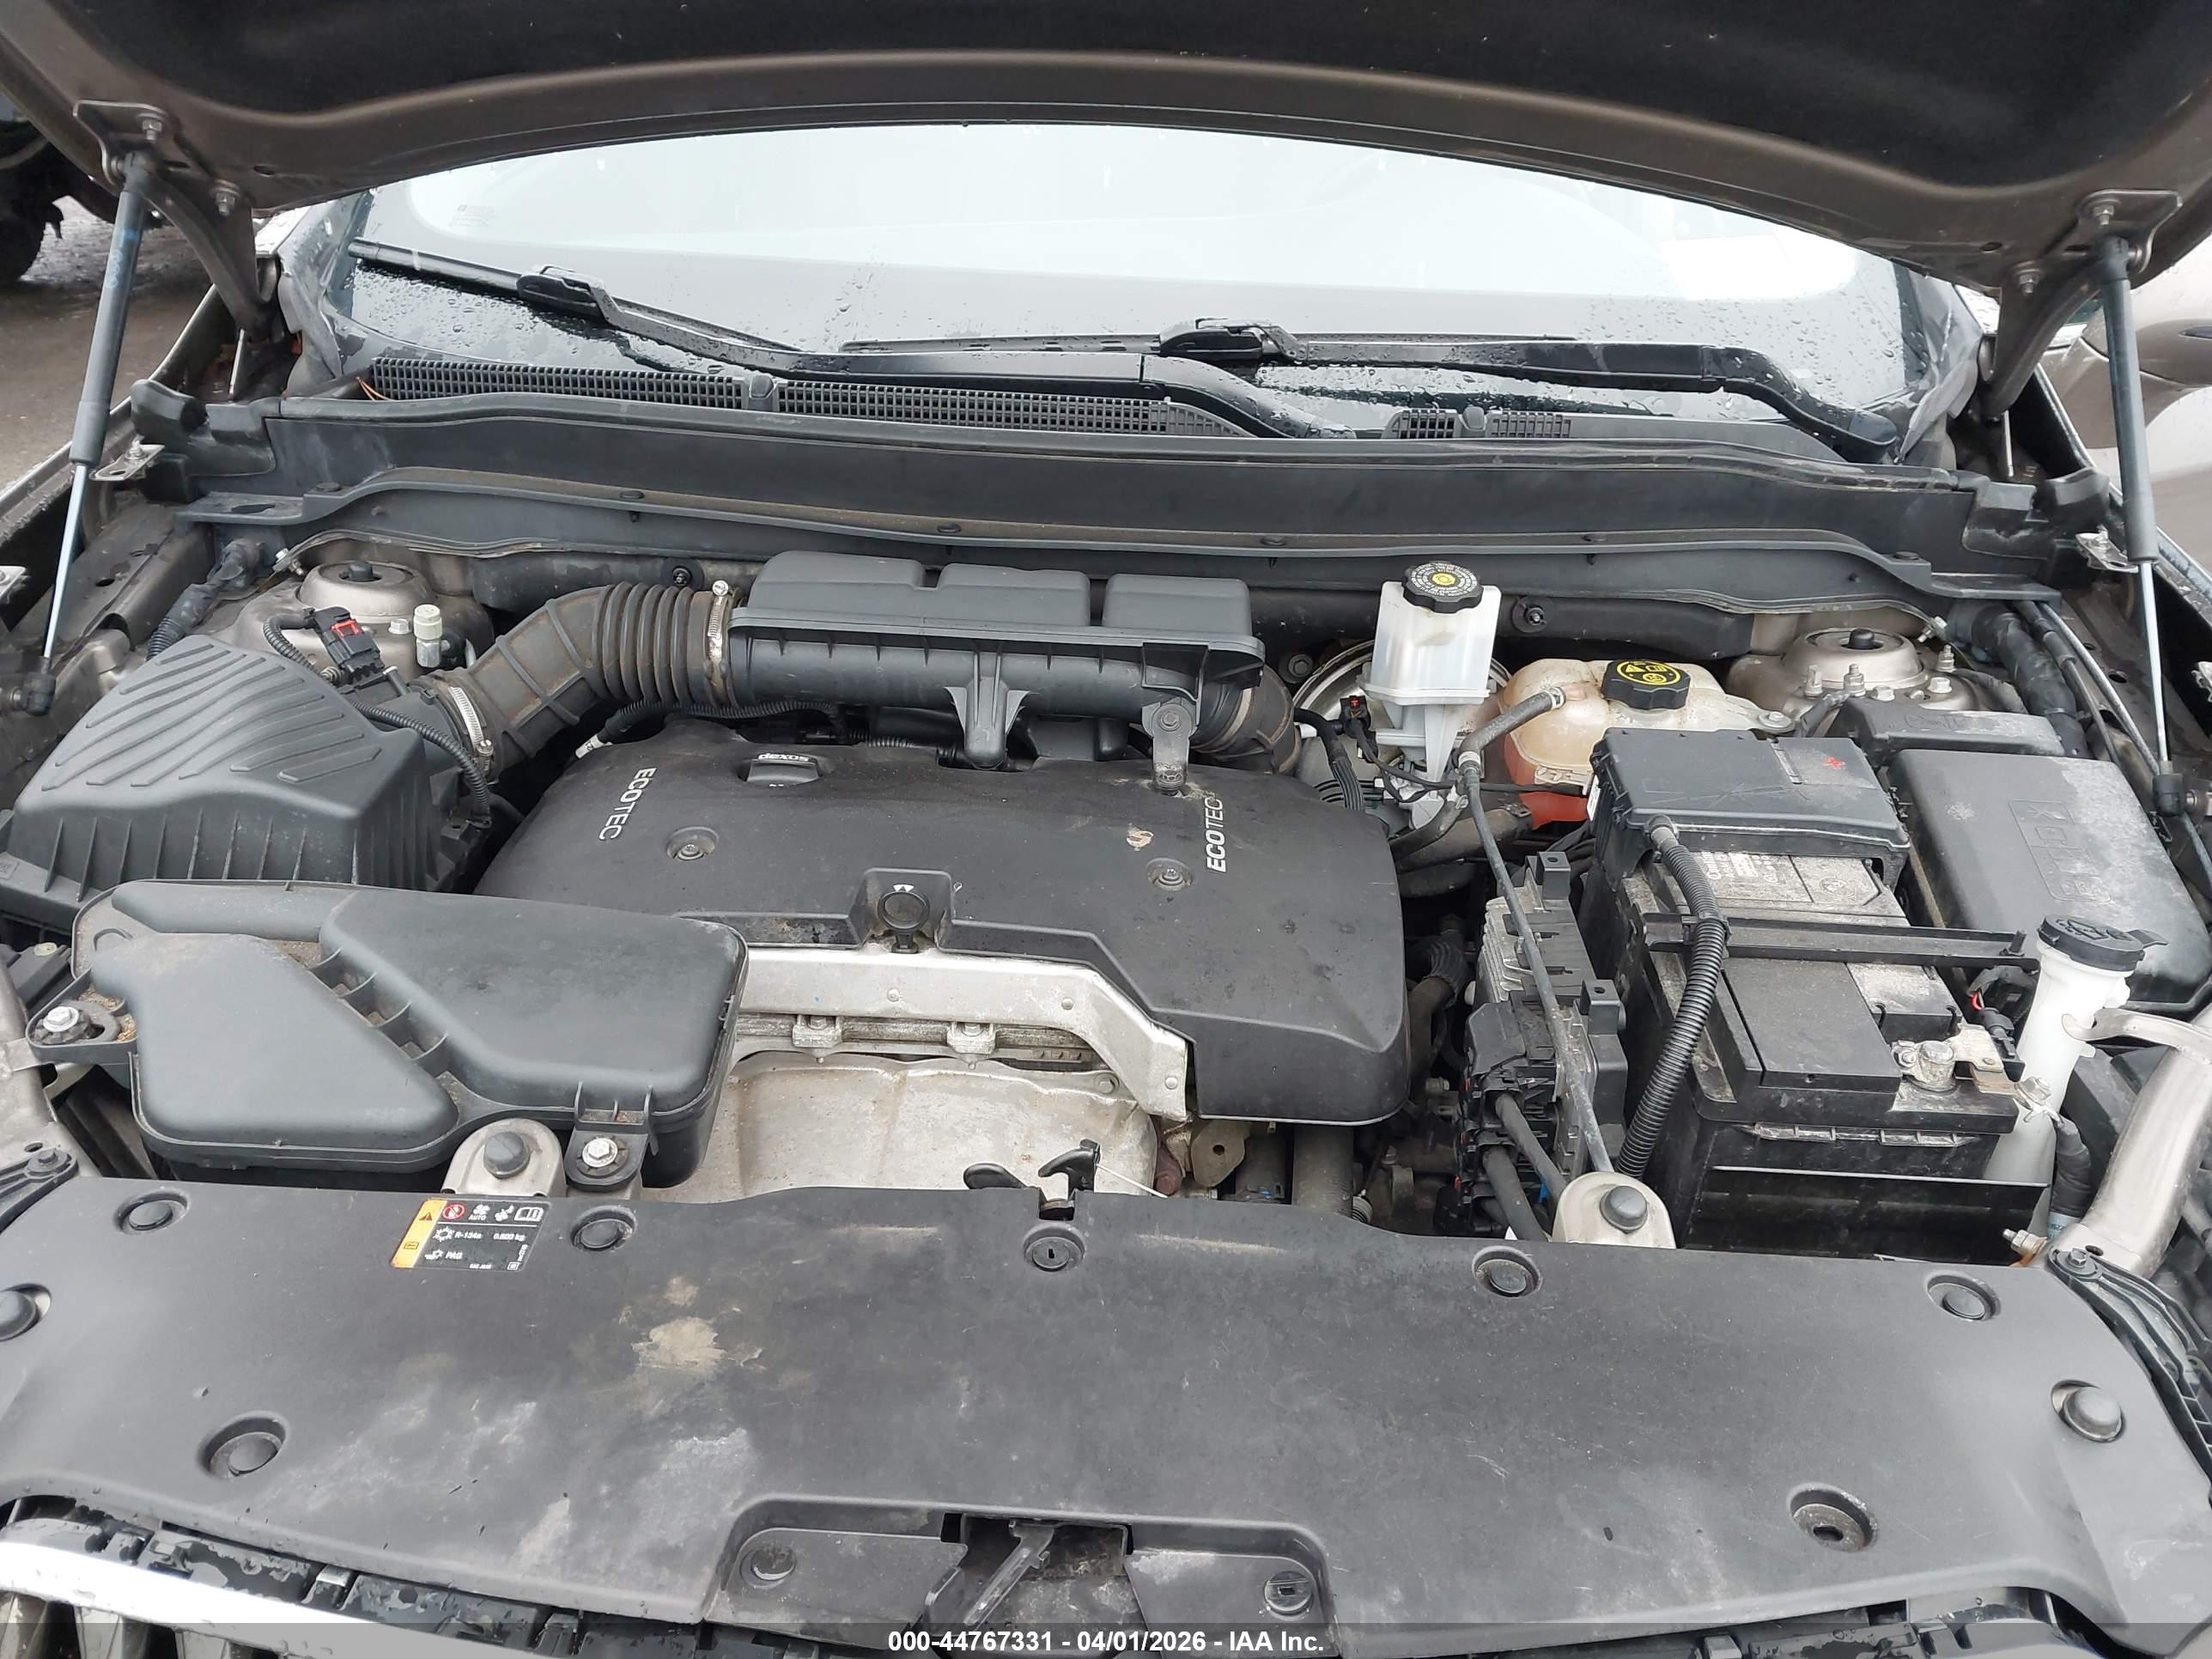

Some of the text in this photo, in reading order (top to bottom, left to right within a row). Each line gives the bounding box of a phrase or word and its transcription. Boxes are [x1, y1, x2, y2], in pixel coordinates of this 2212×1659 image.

[758, 753, 809, 762] dexos
[599, 767, 657, 840] ECOTEC
[1204, 797, 1226, 872] ECOTEC
